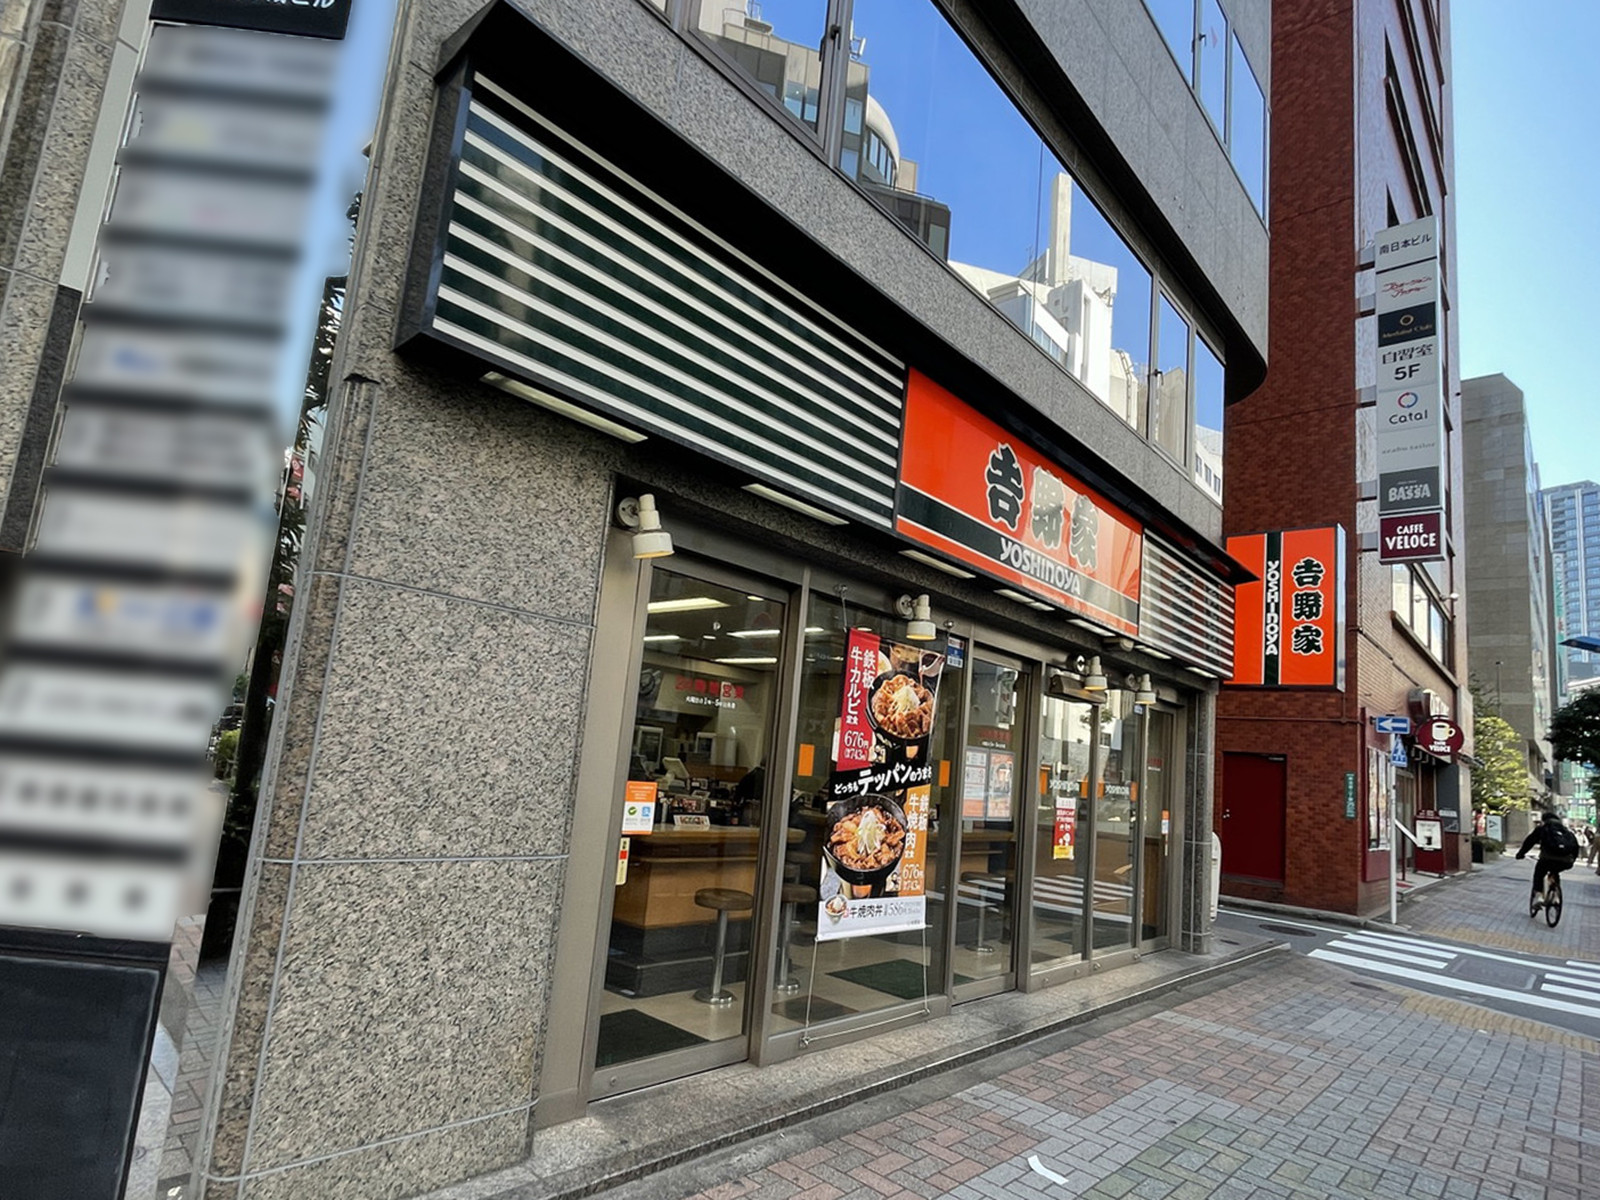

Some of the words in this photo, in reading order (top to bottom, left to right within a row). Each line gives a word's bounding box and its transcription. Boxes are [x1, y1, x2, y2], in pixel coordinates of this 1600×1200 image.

[1379, 234, 1432, 255] 南日本ビル
[1382, 344, 1433, 364] 自習室
[1394, 363, 1421, 381] 5F
[1388, 409, 1428, 425] Catal
[1388, 483, 1431, 502] BASSA
[1396, 523, 1424, 534] CAFFE
[1385, 532, 1436, 550] VELOCE
[999, 537, 1082, 596] YOSHINOYA
[1265, 560, 1280, 656] YOSHINOYA
[1291, 556, 1326, 656] 吉野家
[862, 649, 876, 690] 鉄板
[844, 730, 869, 749] 676円
